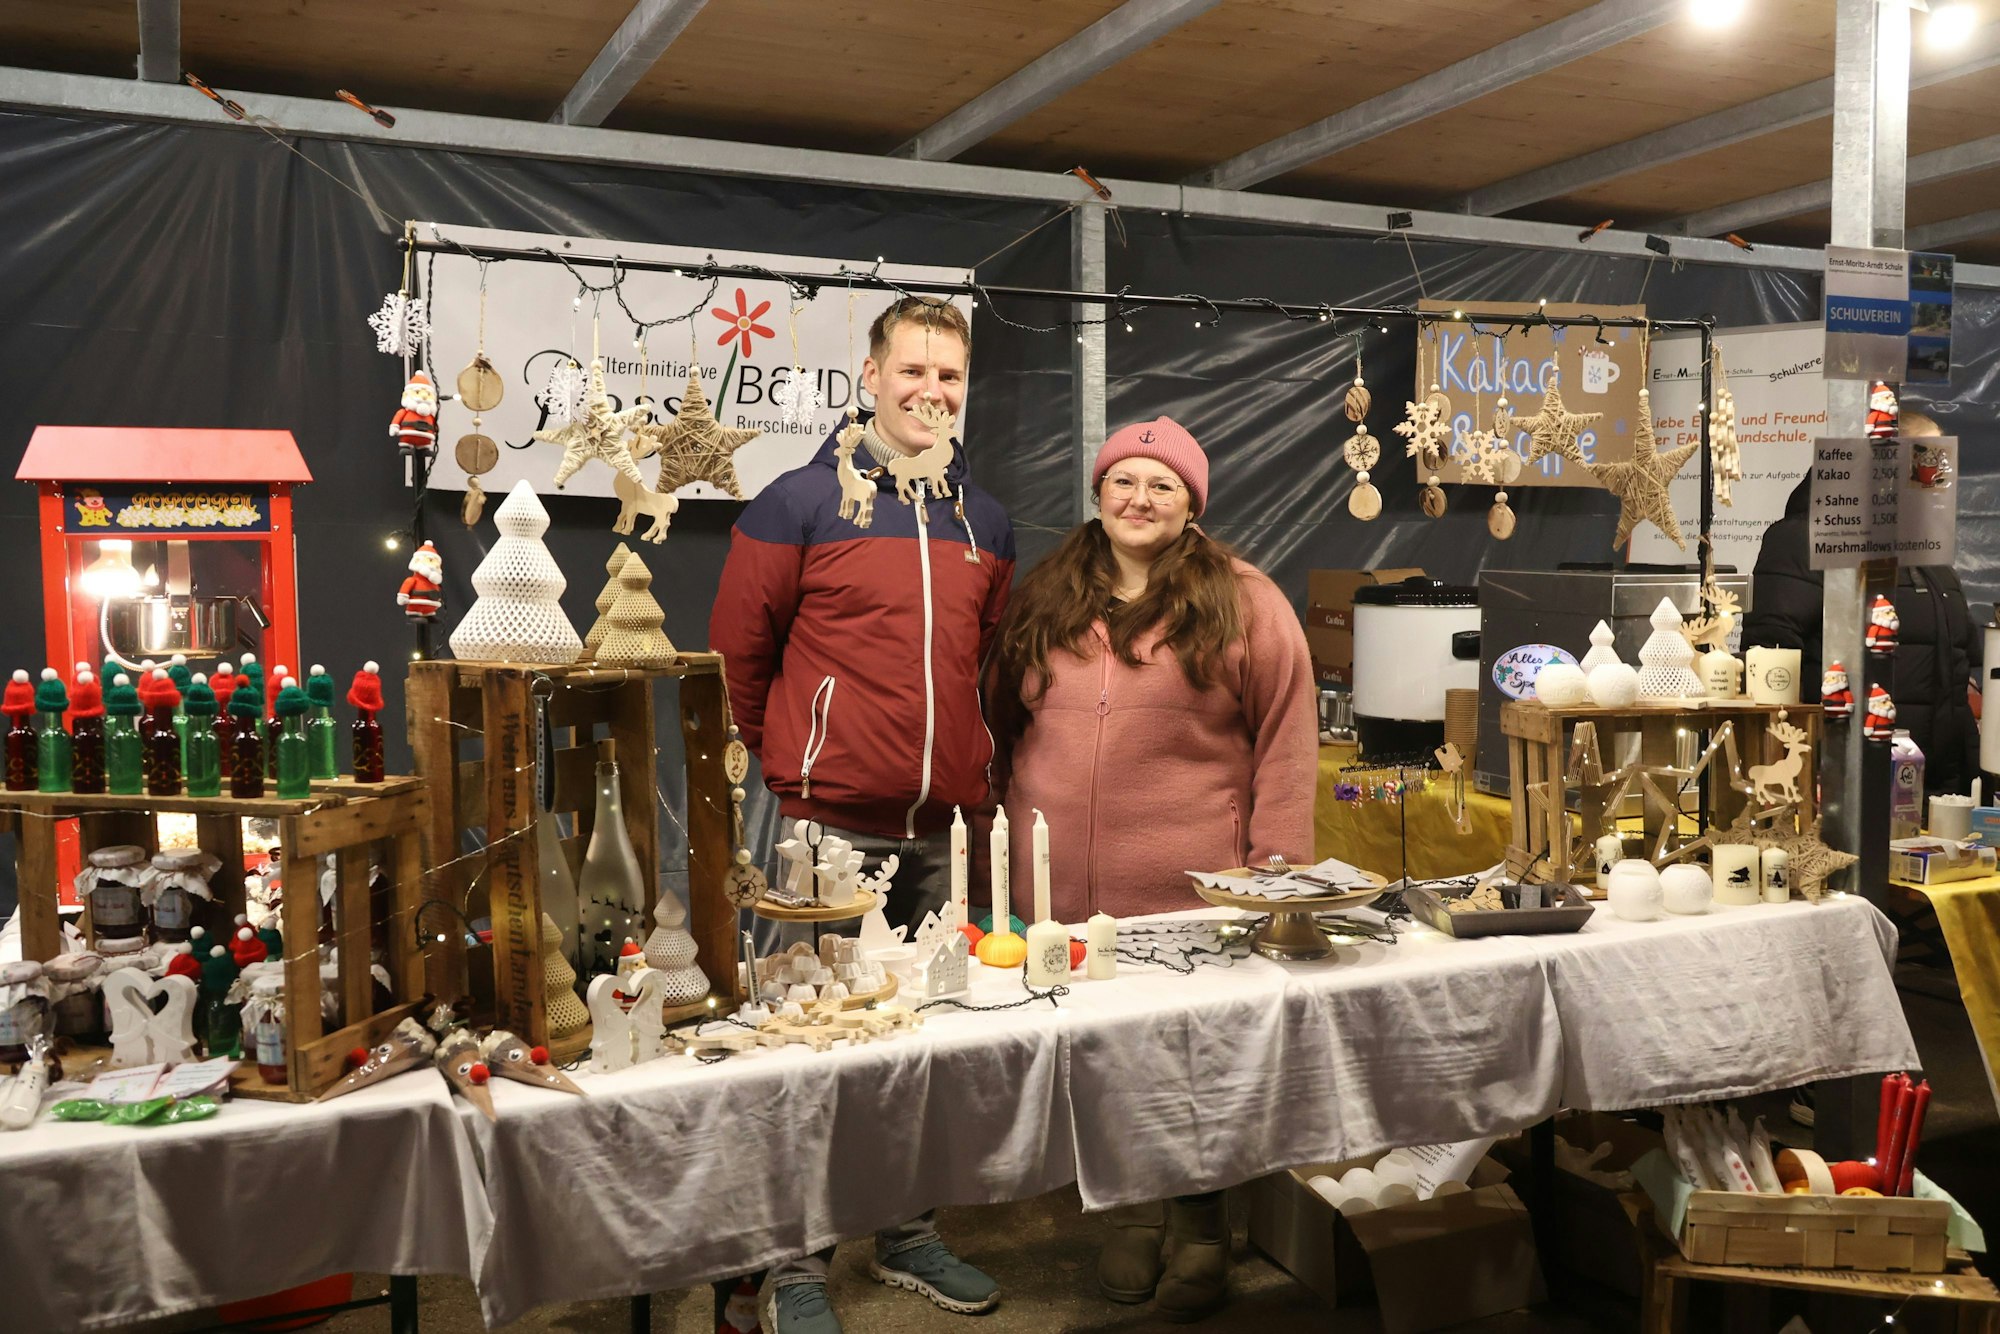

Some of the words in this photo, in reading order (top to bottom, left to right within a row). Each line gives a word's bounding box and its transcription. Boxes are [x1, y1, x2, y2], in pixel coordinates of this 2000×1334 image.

[1829, 258, 1884, 270] Ernst-Moritz-Arndt
[1884, 262, 1903, 271] Schule
[1830, 306, 1901, 323] SCHULVEREIN
[598, 356, 717, 380] lterninitiatve
[1769, 354, 1824, 382] Schulvere
[1652, 416, 1685, 429] iebe
[1741, 413, 1767, 426] und
[1654, 435, 1670, 446] er
[1818, 449, 1853, 461] Kaffee
[1766, 471, 1800, 482] Aufgabe
[1817, 469, 1850, 480] Kakao
[131, 492, 257, 512] POPCORN
[1825, 494, 1859, 506] Sahne
[1680, 518, 1693, 526] und
[1824, 514, 1861, 526] Schuss
[1815, 541, 1892, 554] Marshmallows
[1893, 539, 1941, 550] kostenlos
[1507, 652, 1543, 664] Alles
[1509, 671, 1535, 694] Spe
